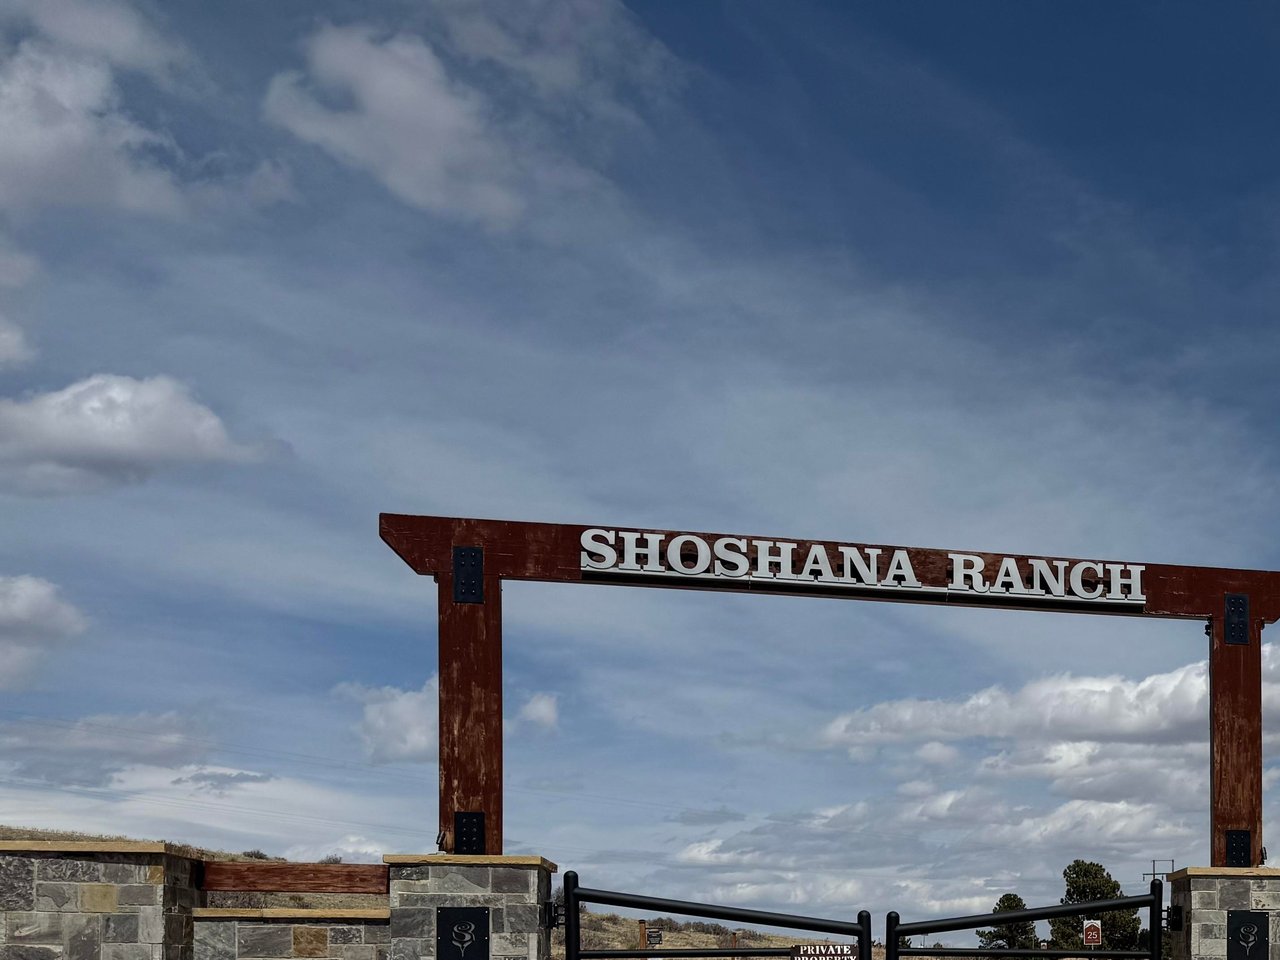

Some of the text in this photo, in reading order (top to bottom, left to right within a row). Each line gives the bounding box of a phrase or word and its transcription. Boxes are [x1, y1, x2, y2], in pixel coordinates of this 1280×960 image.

[580, 528, 1146, 601] SHOSHANA RANCH
[1087, 931, 1098, 939] 25
[800, 945, 851, 954] PRIVATE
